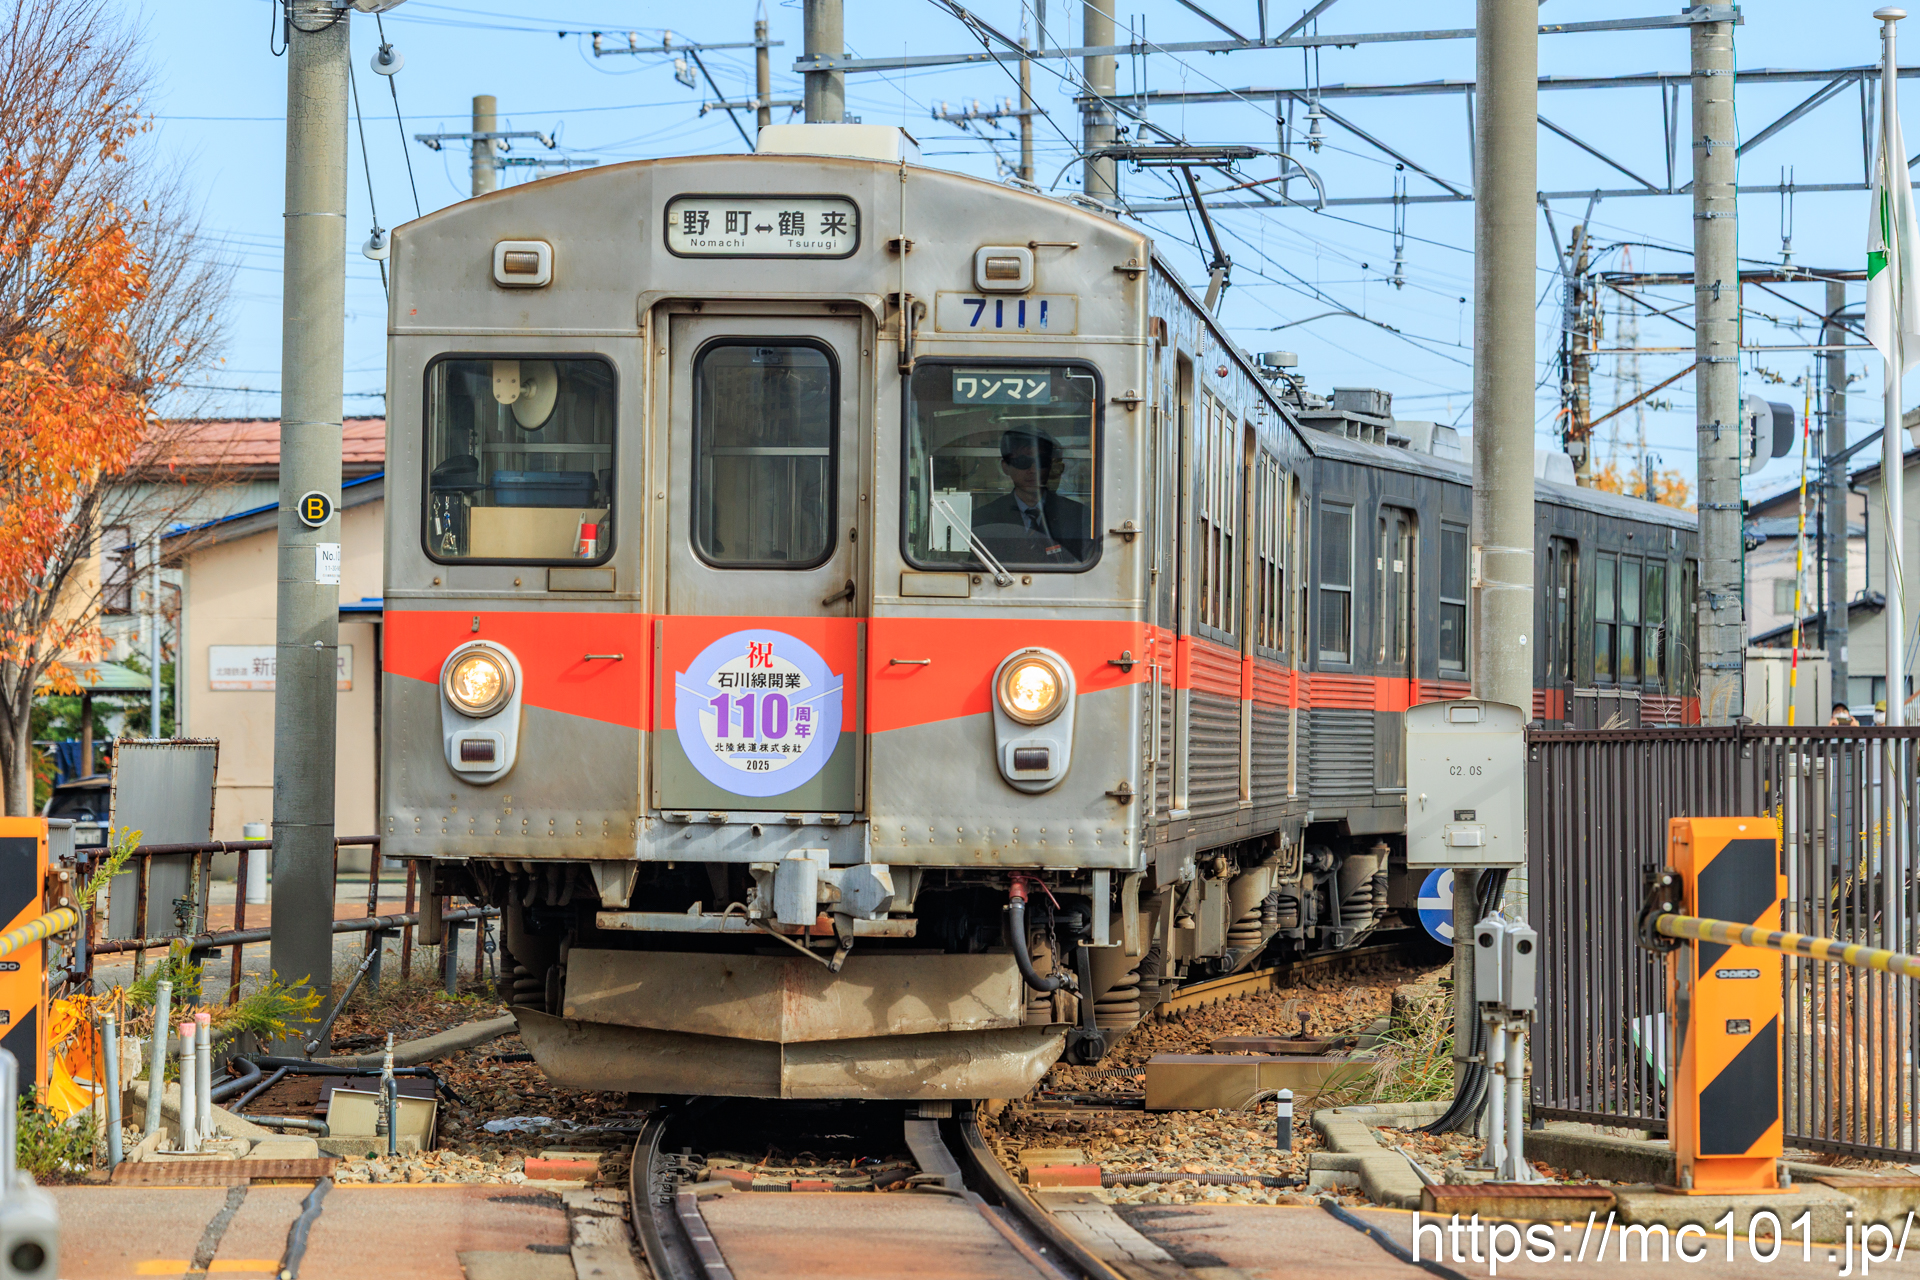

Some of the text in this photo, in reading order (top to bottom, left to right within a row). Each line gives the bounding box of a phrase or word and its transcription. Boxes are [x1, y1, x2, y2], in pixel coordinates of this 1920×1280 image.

[683, 210, 847, 237] 野町 鶴来
[690, 238, 837, 250] Nomachi Tsurugi
[963, 298, 1048, 329] 7111
[956, 377, 1047, 399] ワンマン
[307, 498, 324, 519] B
[746, 640, 774, 669] 祝
[718, 672, 801, 689] 石川線開業
[710, 692, 811, 739] 110 周年
[715, 742, 802, 753] 北陸鉄道株式会社
[746, 760, 770, 770] 2025
[1718, 969, 1759, 978] DAIDO
